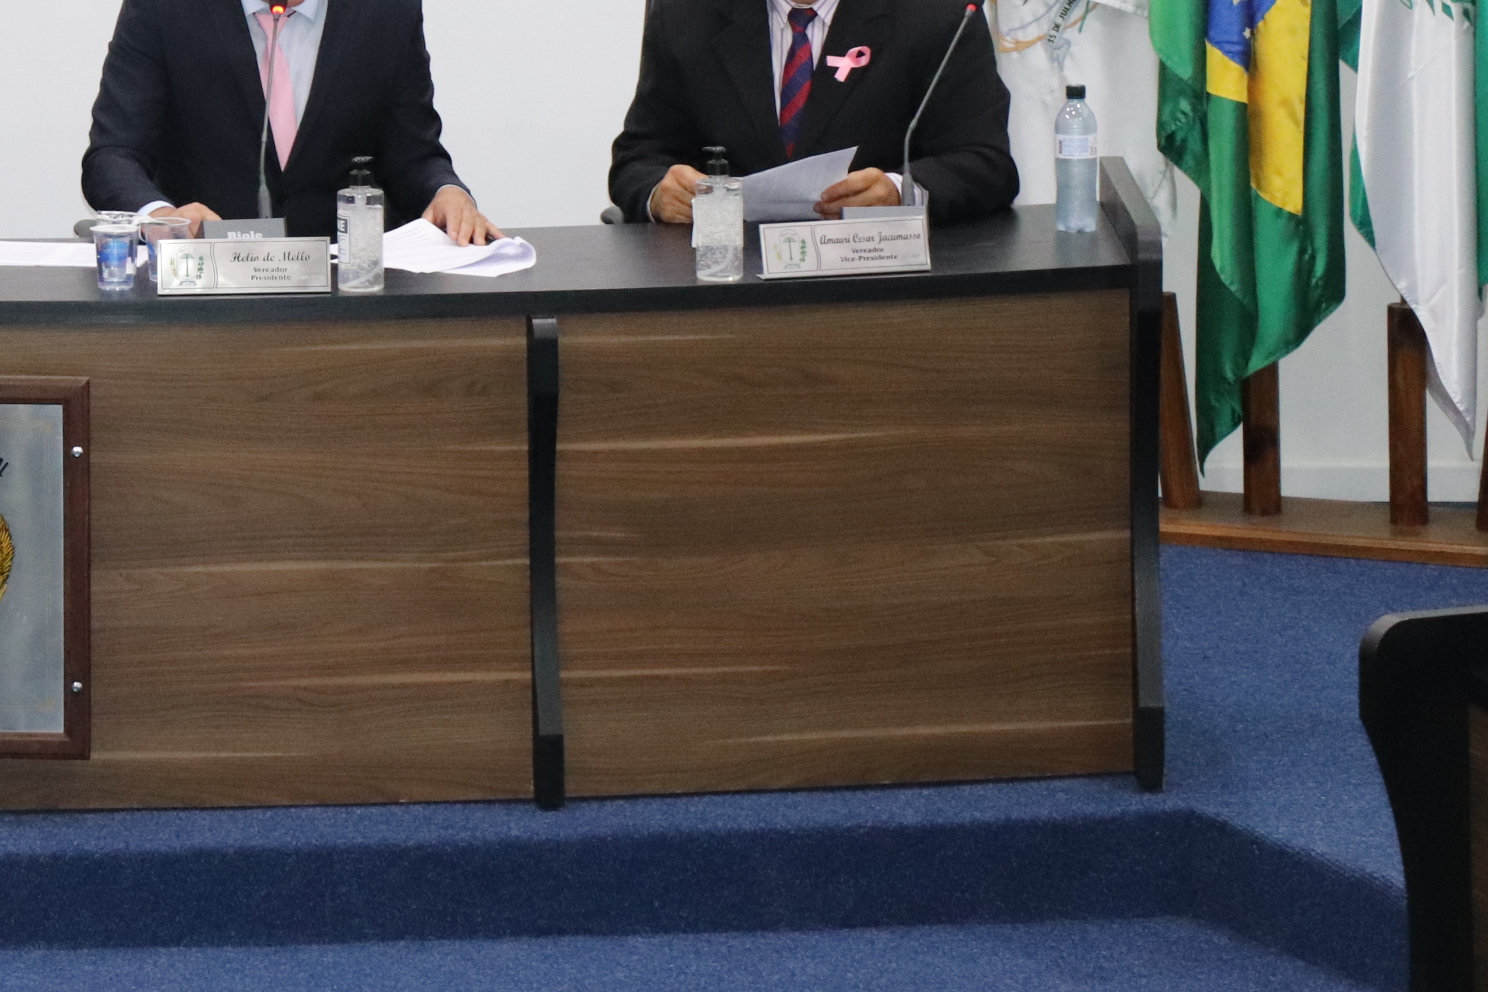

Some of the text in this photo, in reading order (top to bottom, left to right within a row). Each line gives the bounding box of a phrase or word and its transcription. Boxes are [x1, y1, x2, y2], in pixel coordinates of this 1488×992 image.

[1052, 21, 1062, 33] DE
[227, 231, 263, 239] Riole
[820, 234, 851, 245] Amauri
[878, 231, 921, 244] Jacumasso
[262, 252, 275, 262] de
[279, 251, 311, 262] Mello
